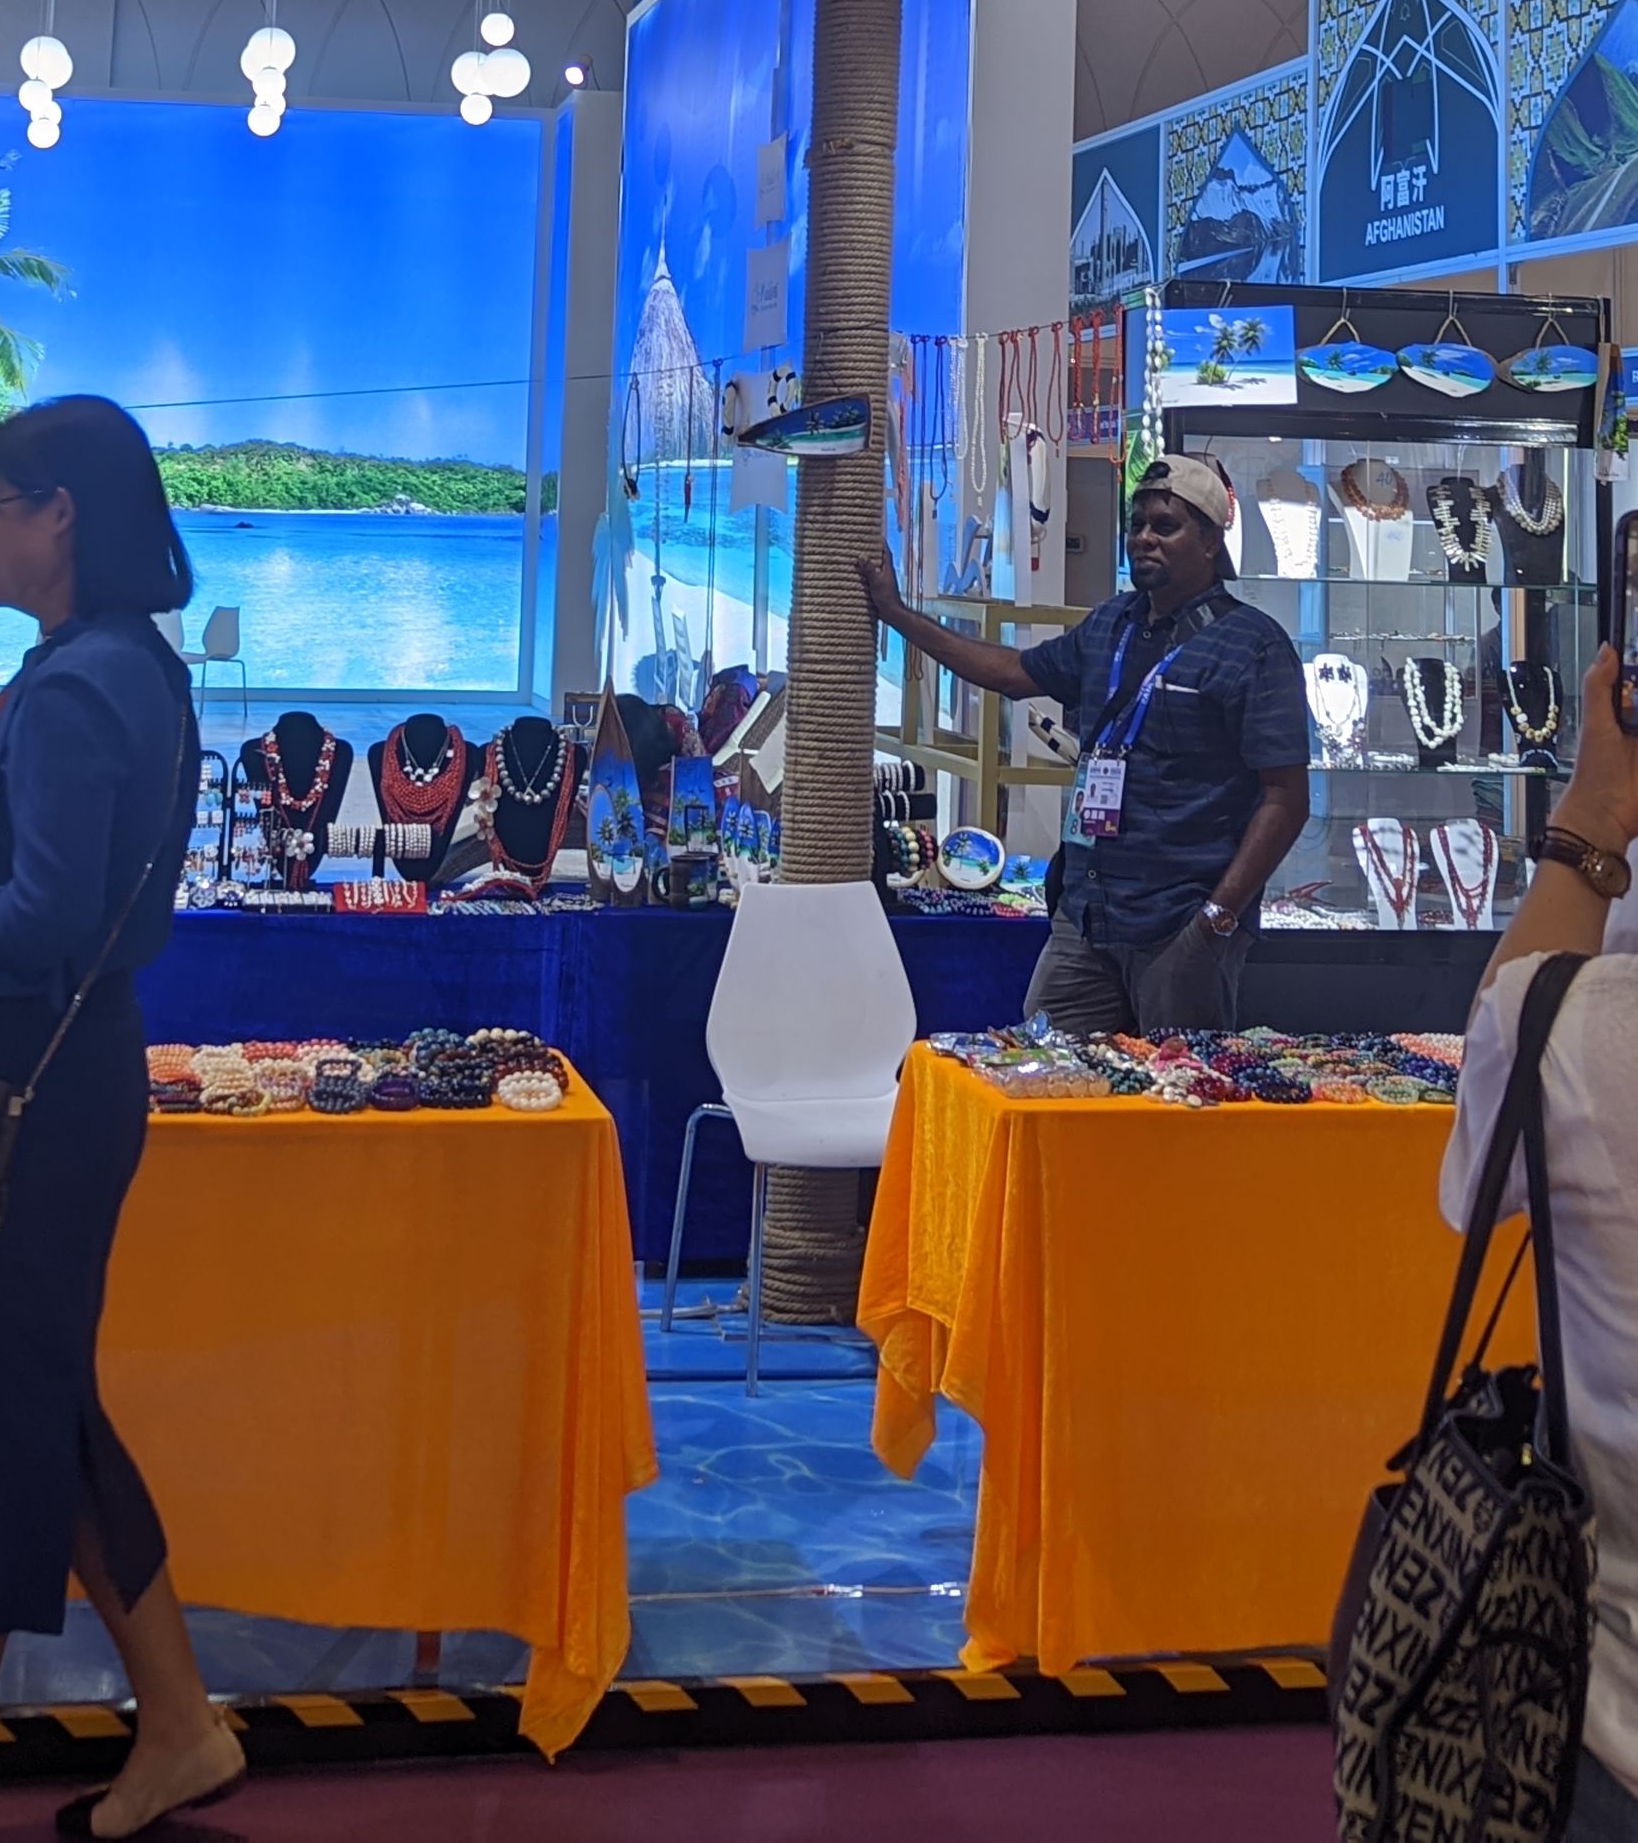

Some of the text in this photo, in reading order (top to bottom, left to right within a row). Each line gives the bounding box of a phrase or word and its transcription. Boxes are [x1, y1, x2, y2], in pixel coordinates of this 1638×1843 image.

[1380, 165, 1428, 212] 阿富汗
[1365, 205, 1445, 246] AFGHANISTAN
